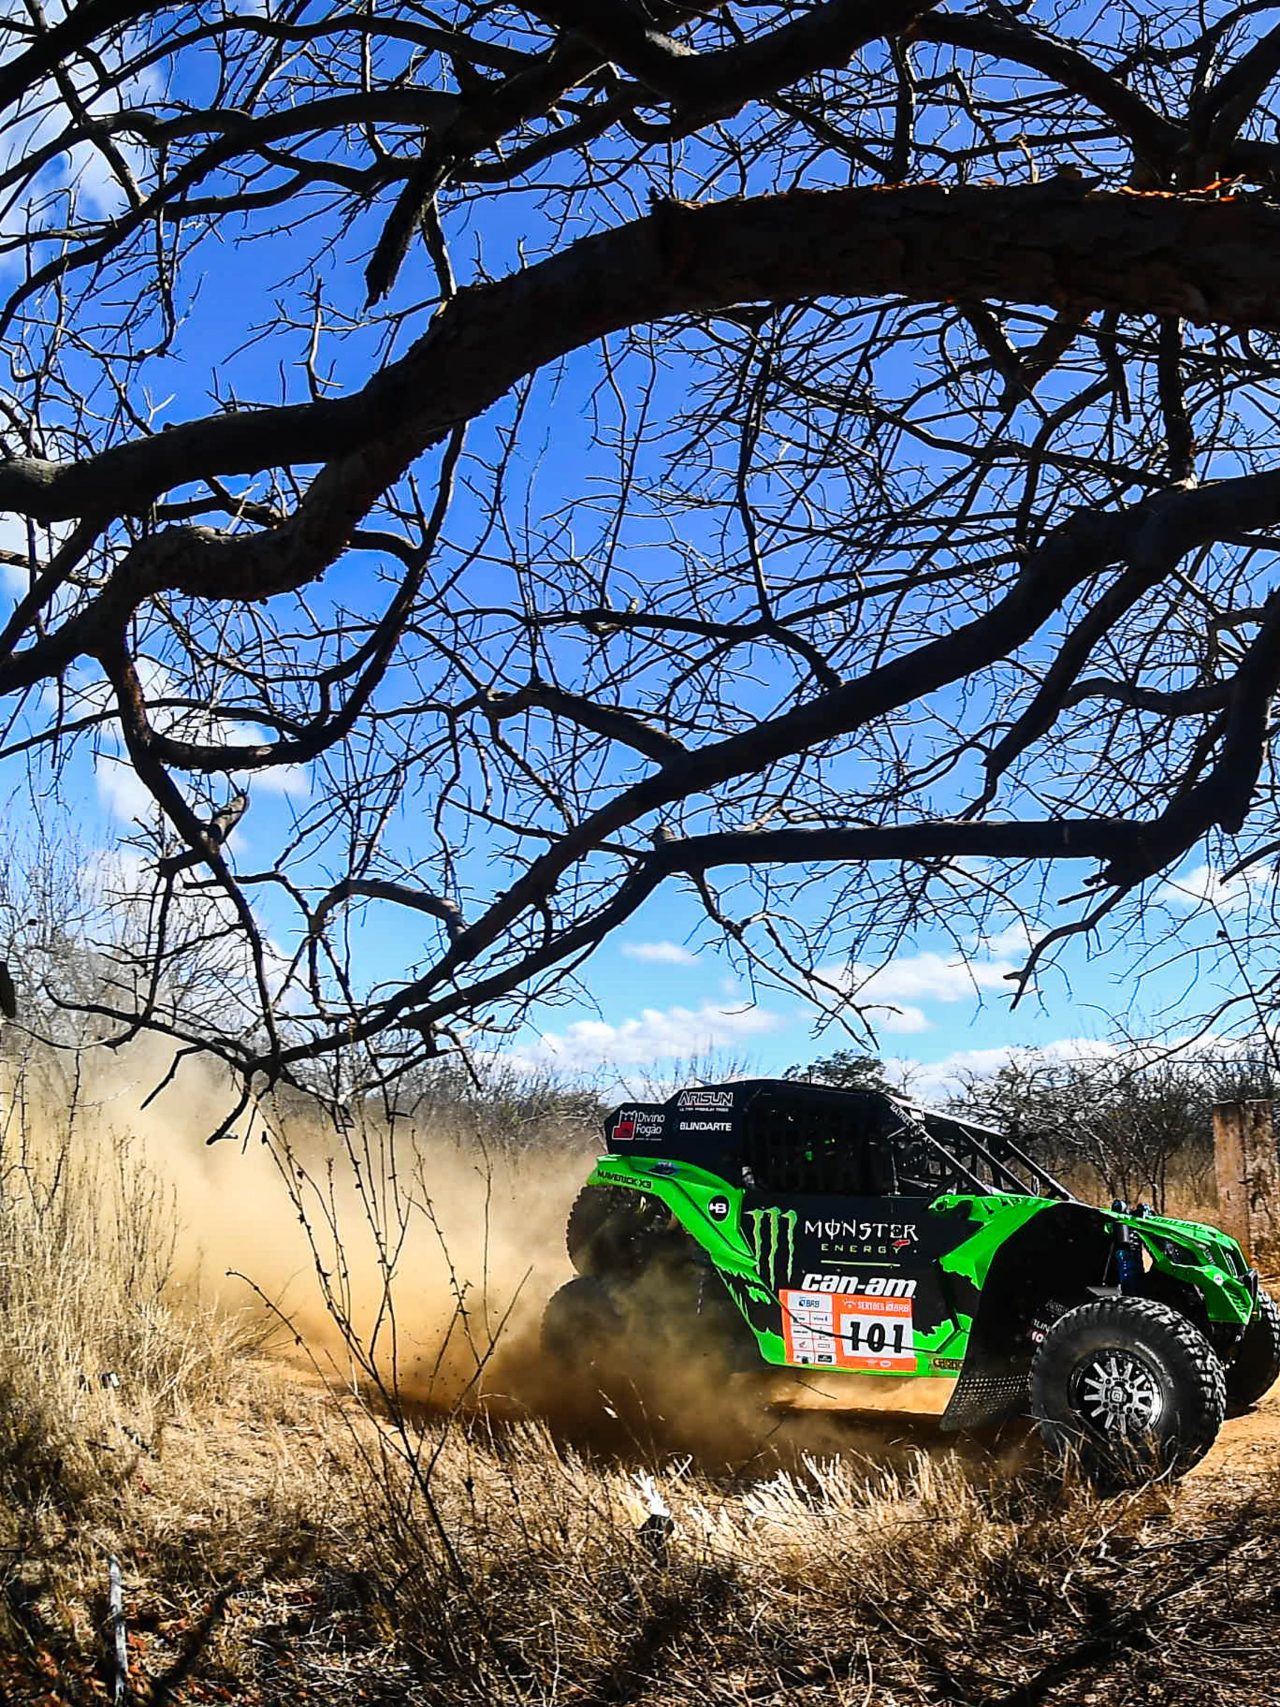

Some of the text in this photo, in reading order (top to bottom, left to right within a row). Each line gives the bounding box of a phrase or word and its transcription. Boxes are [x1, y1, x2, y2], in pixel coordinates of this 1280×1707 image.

[677, 1091, 734, 1107] ARISUN
[637, 1112, 665, 1123] Divino
[636, 1123, 662, 1137] Fogão
[679, 1121, 732, 1132] BLINDARTE
[804, 1219, 919, 1241] MONSTER
[820, 1243, 902, 1254] ENERGY
[801, 1273, 917, 1298] can-am
[850, 1321, 904, 1354] 101
